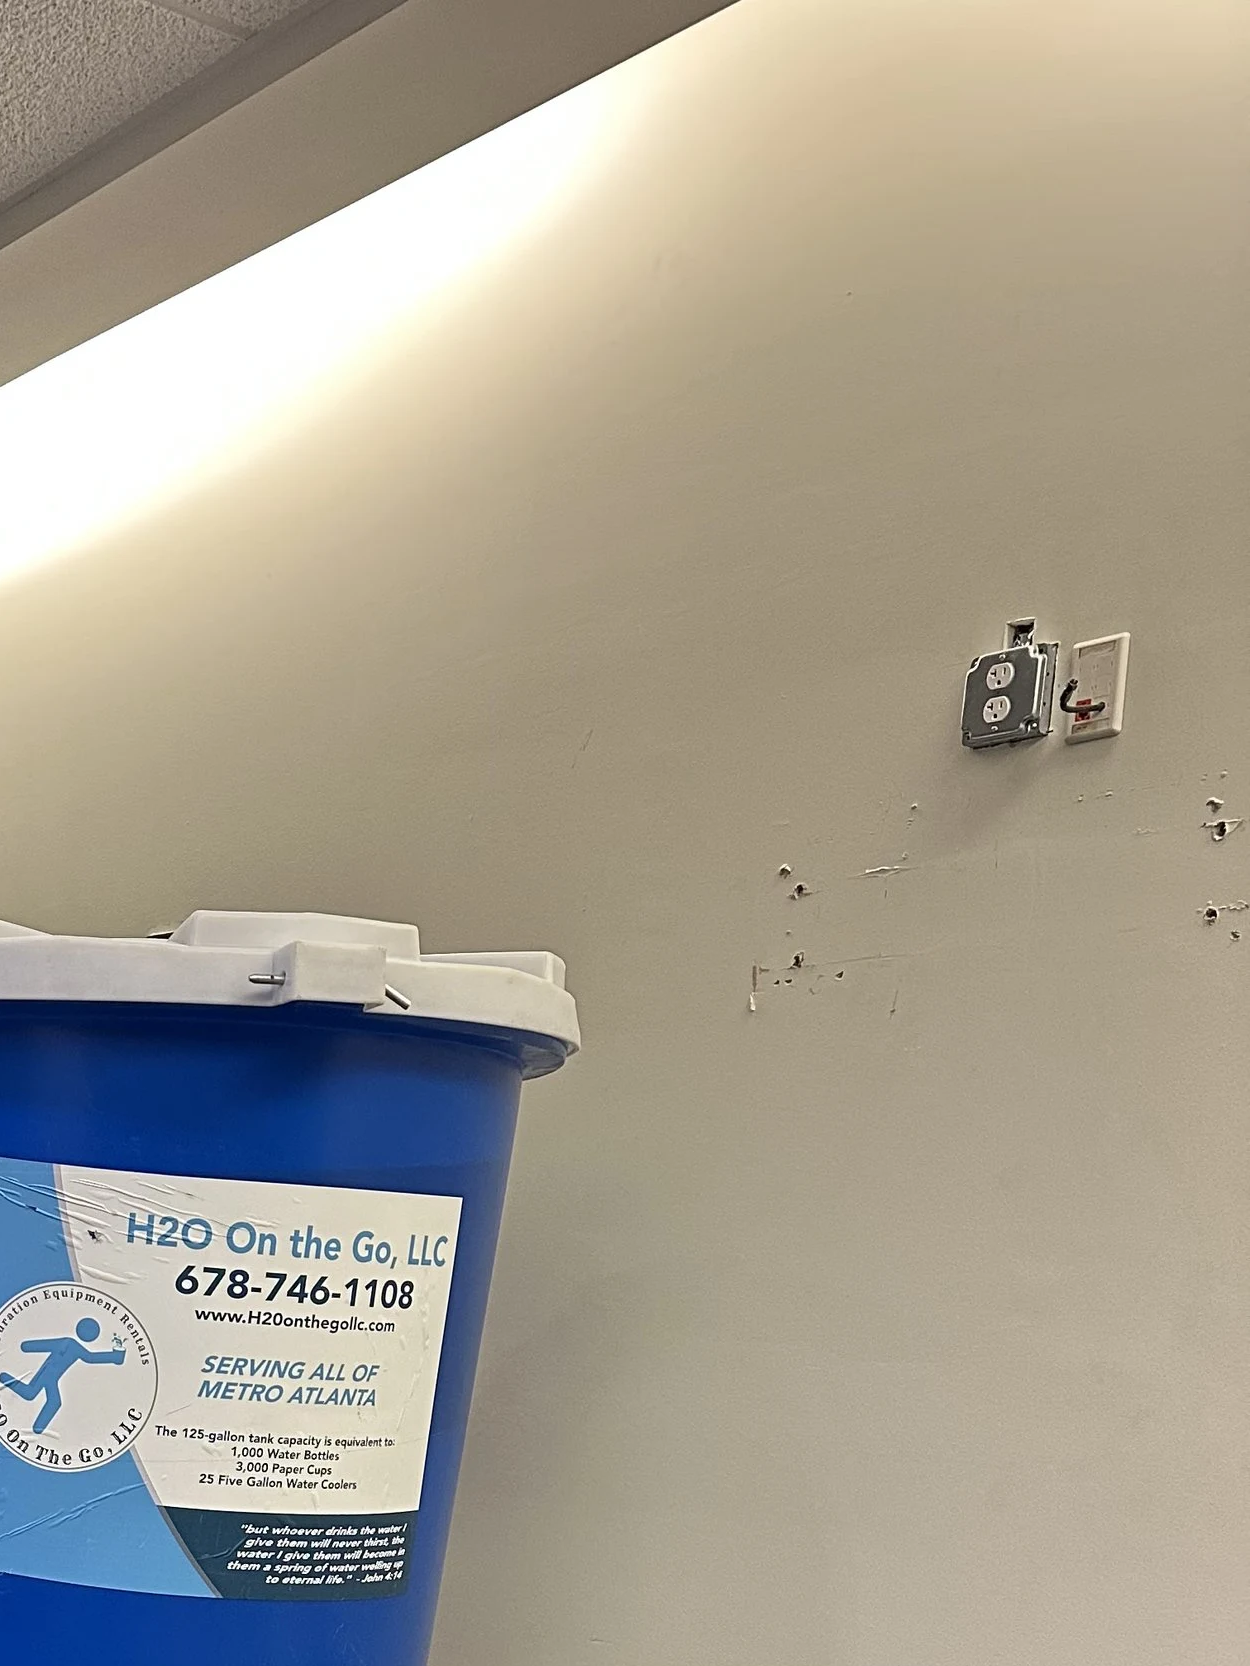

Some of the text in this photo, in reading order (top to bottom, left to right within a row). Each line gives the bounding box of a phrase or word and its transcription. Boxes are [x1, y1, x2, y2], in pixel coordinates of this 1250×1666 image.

[226, 1221, 277, 1256] On
[290, 1225, 341, 1261] the
[353, 1230, 398, 1270] Go,
[407, 1234, 449, 1267] LLC
[175, 1265, 415, 1309] 678-746-1108
[43, 1288, 118, 1315] Equipment
[119, 1313, 150, 1366] Rentals
[201, 1355, 381, 1383] SERVING ALL OF
[197, 1380, 377, 1407] METRO ATLANTA
[6, 1429, 30, 1454] On
[35, 1444, 72, 1466] The
[78, 1446, 113, 1463] Go,
[110, 1407, 143, 1446] LLC
[155, 1425, 396, 1449] The 125-gallon tank capacity is equivalent to:
[231, 1446, 340, 1461] 1,000 Water Bottles
[235, 1461, 332, 1477] 3,000 Paper Cups
[198, 1473, 357, 1490] 25 Five Gallon Water Coolers
[272, 1525, 324, 1536] whoever
[325, 1525, 358, 1536] drinks
[360, 1525, 376, 1535] the
[378, 1524, 402, 1534] water
[243, 1537, 274, 1548] give
[276, 1537, 308, 1548] them
[310, 1538, 332, 1548] will
[332, 1540, 363, 1548] never
[391, 1535, 405, 1545] the
[236, 1550, 275, 1559] water
[283, 1551, 310, 1562] give
[313, 1551, 341, 1560] them
[344, 1549, 363, 1560] will
[362, 1549, 397, 1560] become
[227, 1560, 261, 1571] them
[274, 1563, 312, 1575] spring
[314, 1562, 330, 1572] of
[330, 1563, 360, 1572] water
[393, 1560, 404, 1571] up
[265, 1575, 280, 1584] to
[282, 1575, 325, 1585] eternal
[361, 1572, 384, 1583] John
[384, 1570, 403, 1581] 4:14
